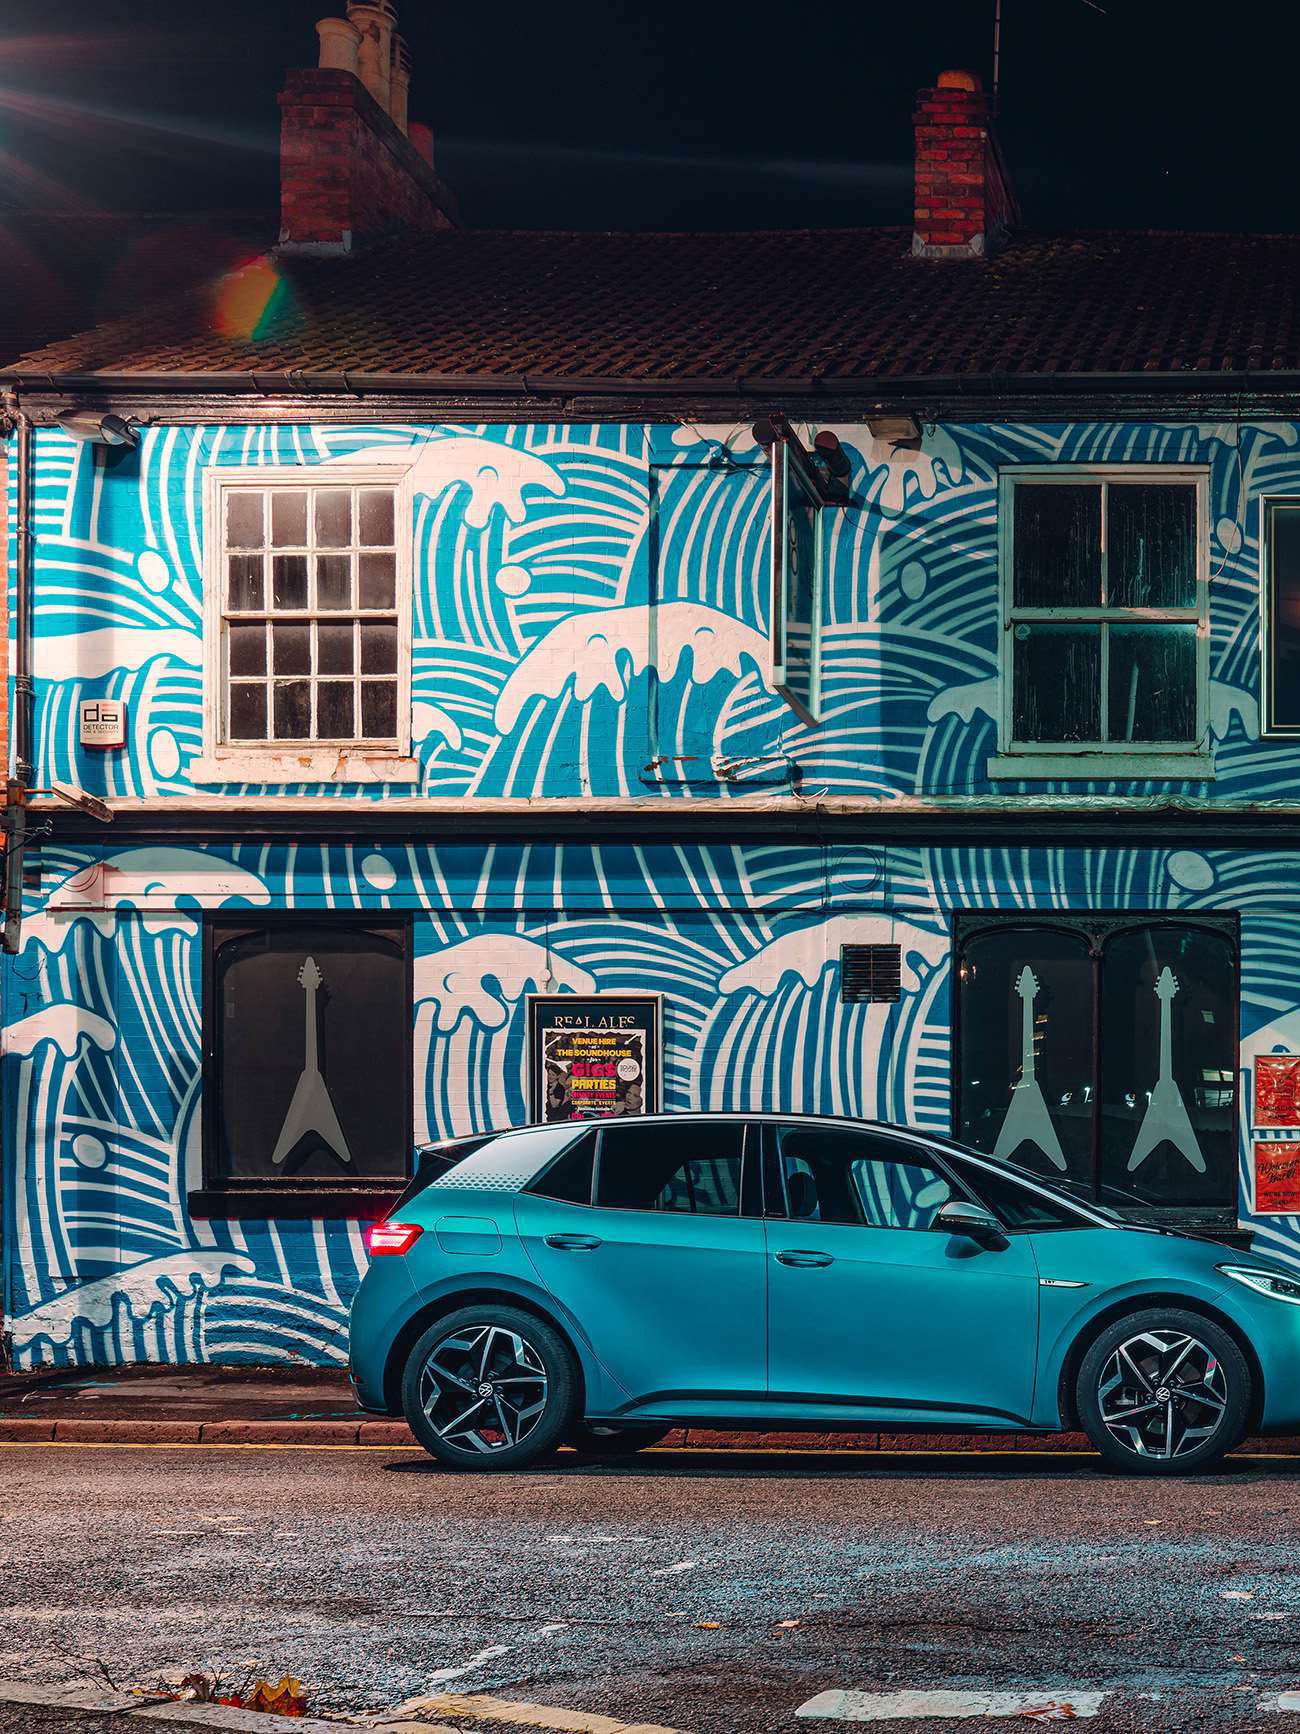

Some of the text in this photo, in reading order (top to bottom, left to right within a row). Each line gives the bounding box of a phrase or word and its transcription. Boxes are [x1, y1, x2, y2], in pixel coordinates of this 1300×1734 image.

[557, 1049, 632, 1057] THE SOUNDHOUSE
[571, 1063, 616, 1077] GIGS
[571, 1080, 616, 1090] PARTIES
